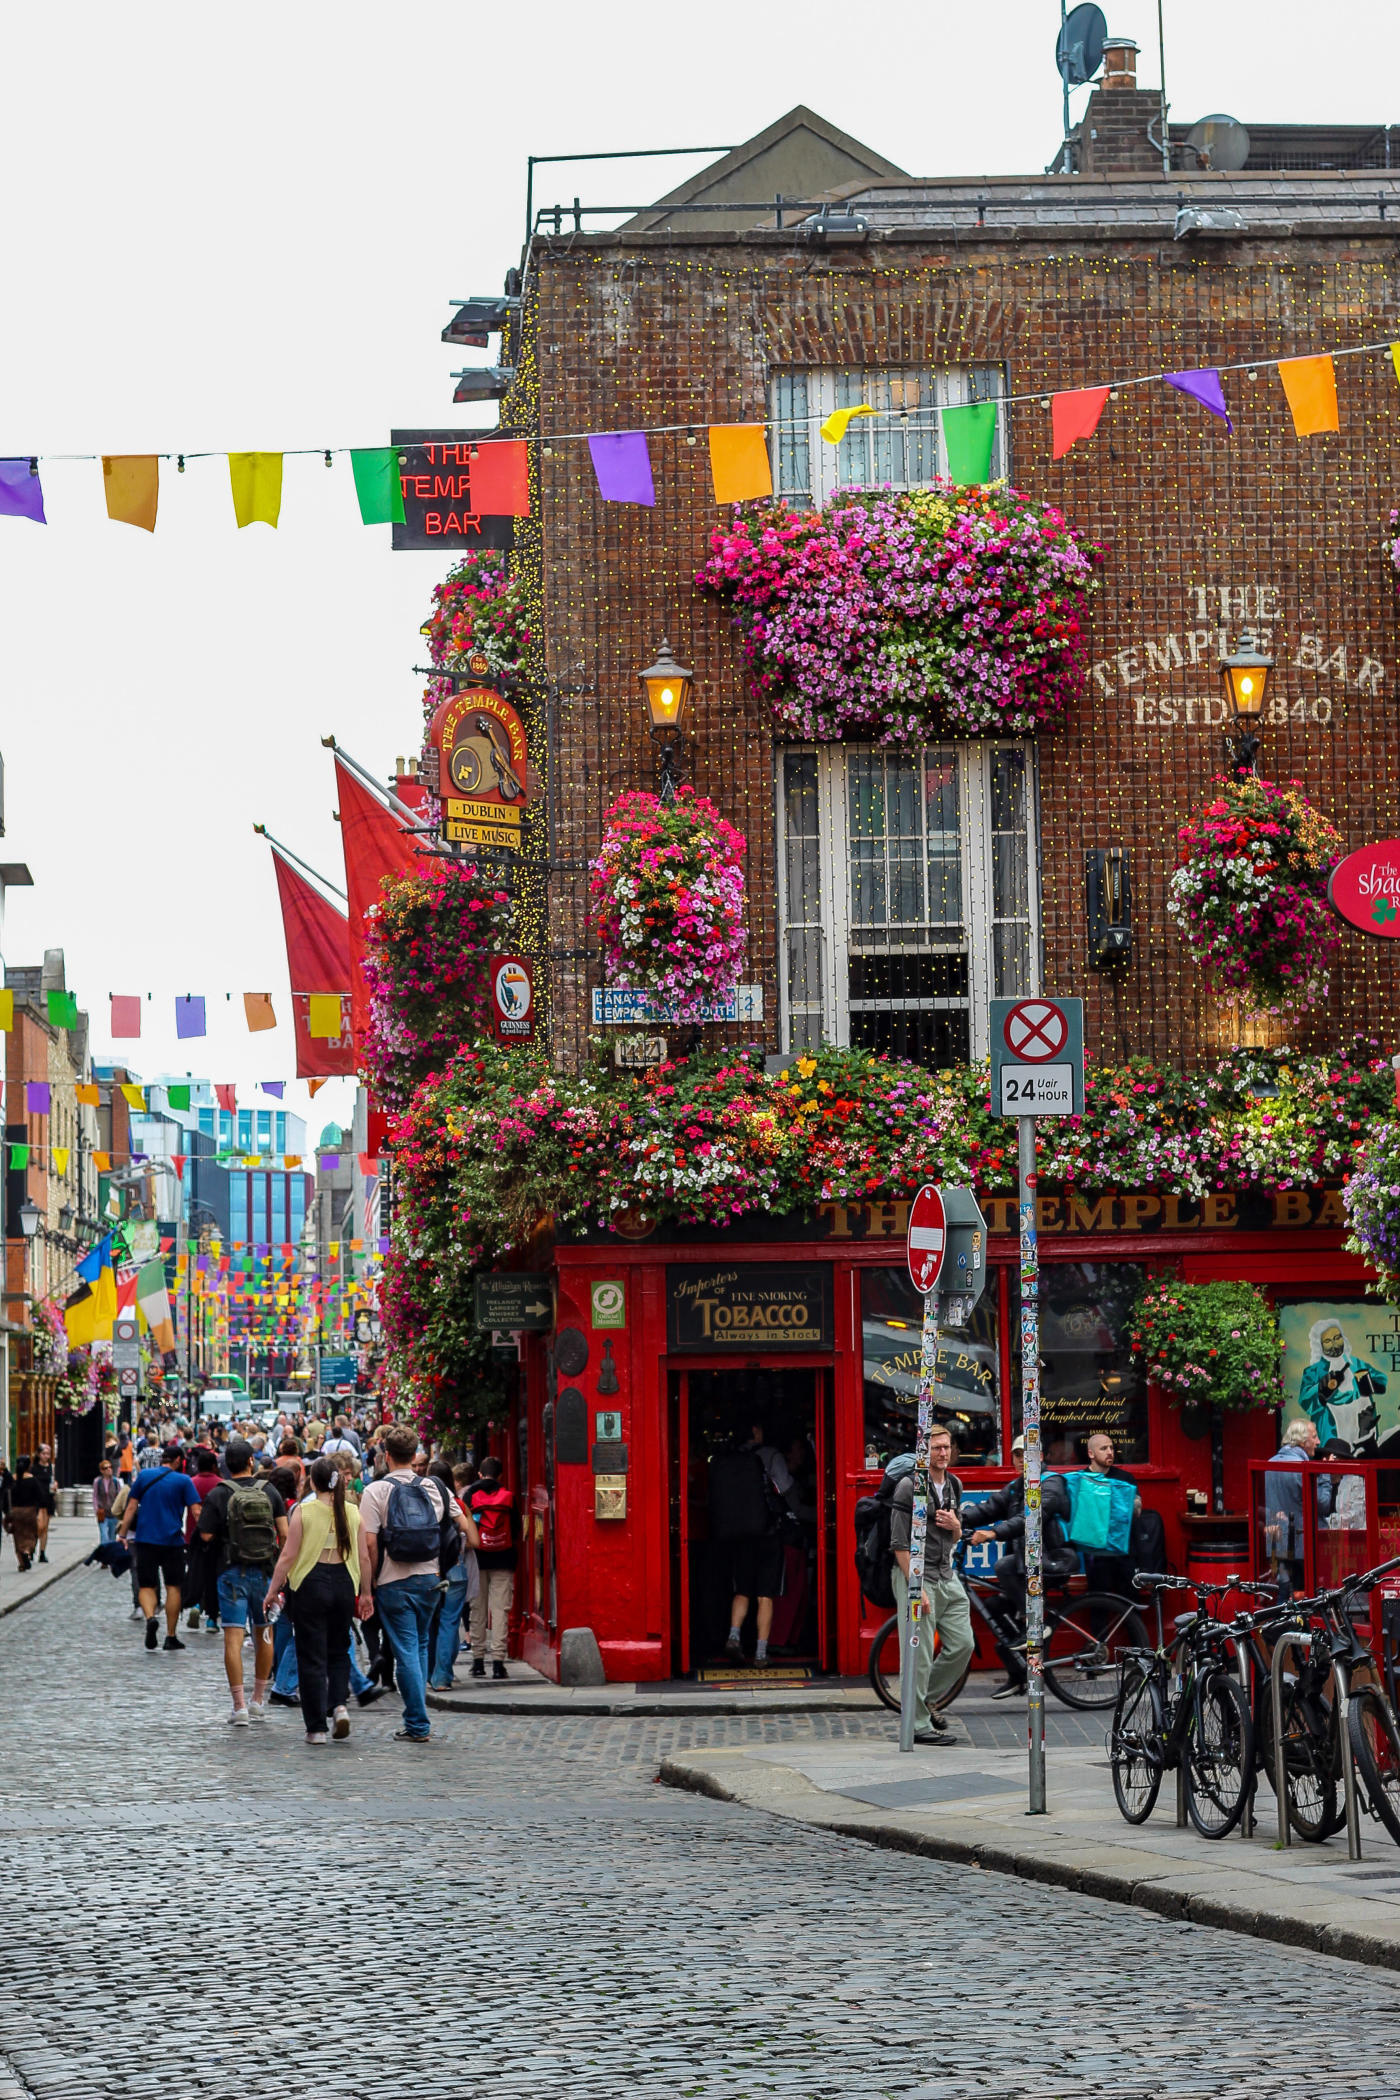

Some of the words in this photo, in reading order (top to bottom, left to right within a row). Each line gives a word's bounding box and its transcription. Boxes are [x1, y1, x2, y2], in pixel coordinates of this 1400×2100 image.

[400, 475, 471, 498] TEMP
[425, 512, 482, 535] BAR
[1188, 586, 1282, 620] THE
[1293, 634, 1385, 697] BAR
[1133, 697, 1228, 725] ESTD
[442, 713, 458, 752] THE
[455, 694, 510, 722] TEMPLE
[507, 720, 524, 761] BAR
[462, 803, 507, 820] DUBLIN
[454, 826, 479, 841] LIVE
[481, 829, 516, 845] MUSIC
[1379, 861, 1398, 876] The
[596, 990, 633, 1005] LÁNA
[744, 995, 754, 1012] 2
[651, 1006, 680, 1019] LAN
[699, 1005, 735, 1017] OUTH
[500, 1021, 530, 1029] GUINNESS
[327, 1037, 353, 1049] BA
[1006, 1079, 1036, 1102] 24
[1037, 1078, 1059, 1088] Uair
[1038, 1091, 1068, 1101] HOUR
[819, 1201, 912, 1236] TH
[980, 1193, 1240, 1236] TEMPLE
[1272, 1190, 1352, 1225] BA
[673, 1271, 739, 1299] Importers
[714, 1287, 726, 1295] OF
[731, 1292, 757, 1302] FINE
[757, 1291, 808, 1302] SMOKING
[692, 1299, 809, 1337] TOBACCO
[715, 1331, 761, 1341] Always
[766, 1331, 778, 1340] in
[782, 1328, 820, 1340] Stock
[918, 1330, 945, 1341] TE
[871, 1348, 949, 1385] TEMPE
[955, 1353, 993, 1386] BAR
[1058, 1397, 1081, 1407] lived
[1081, 1398, 1100, 1406] and
[1100, 1397, 1126, 1407] loved
[1049, 1411, 1085, 1424] laughed
[1086, 1411, 1104, 1421] and
